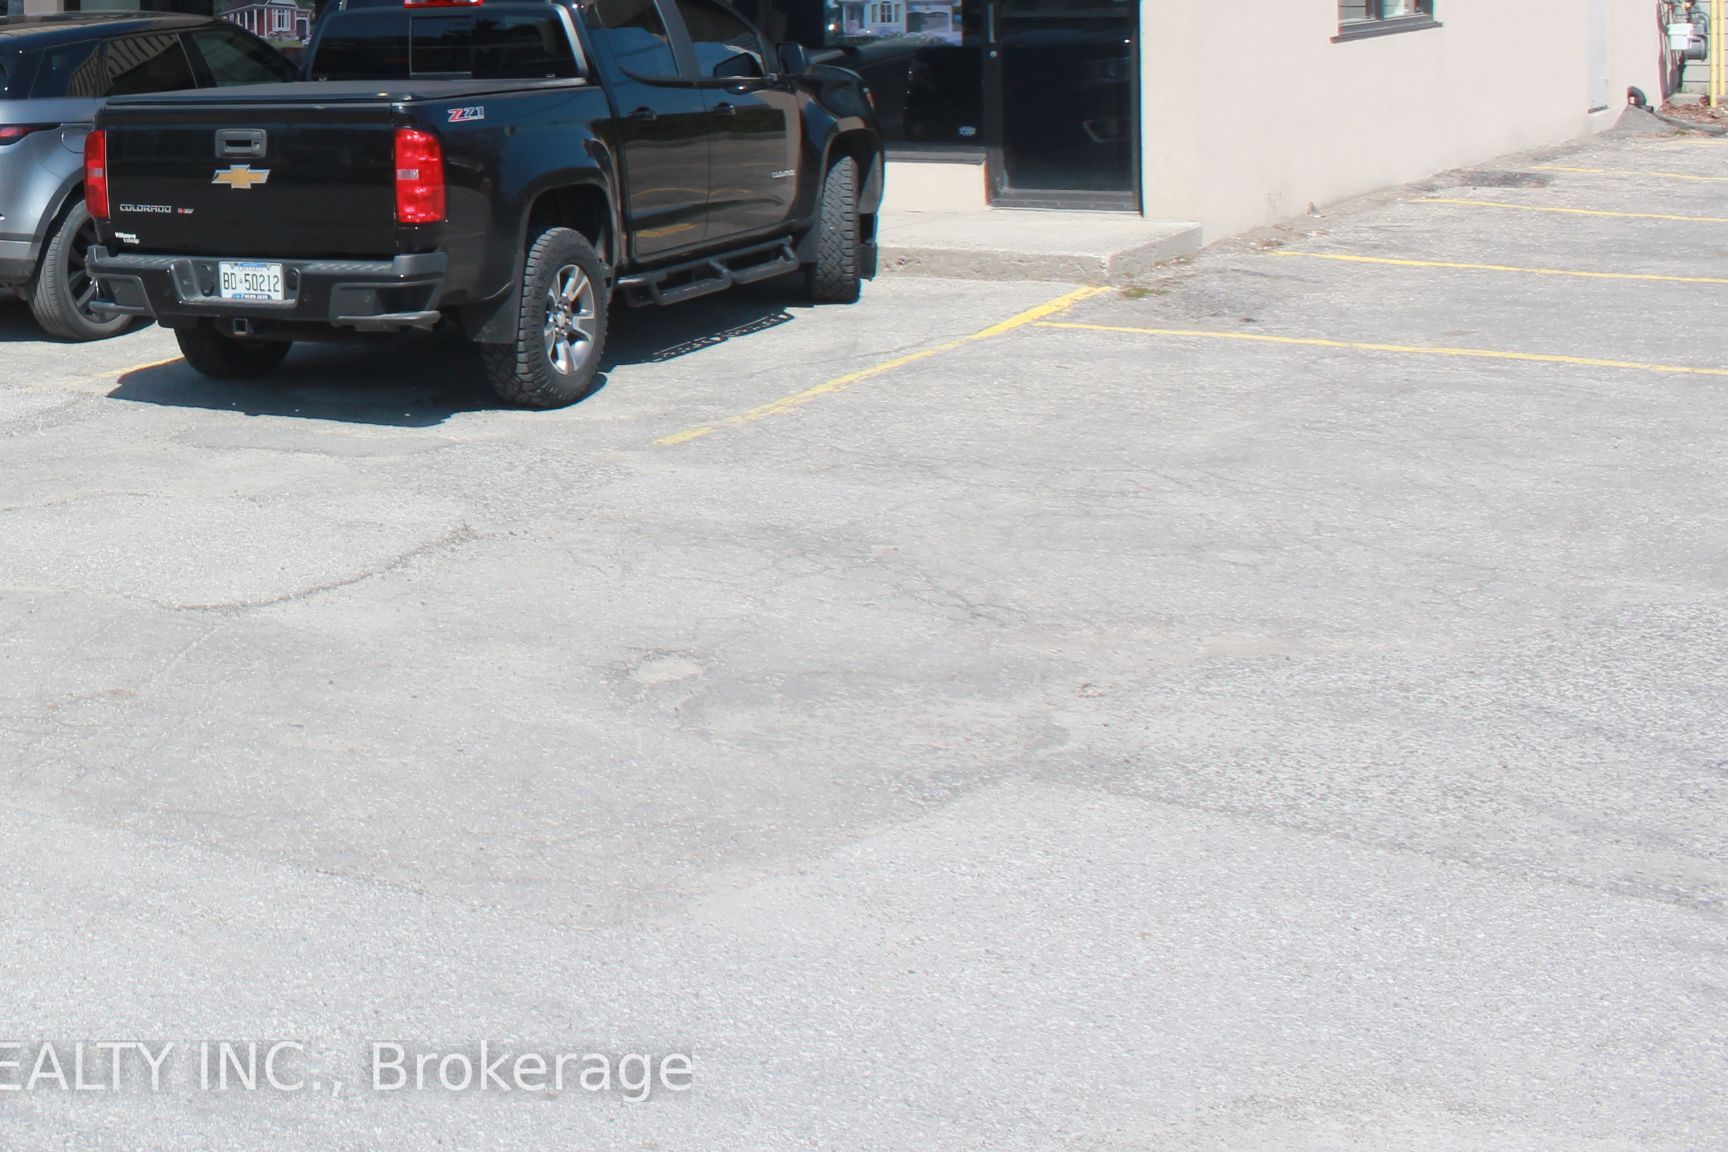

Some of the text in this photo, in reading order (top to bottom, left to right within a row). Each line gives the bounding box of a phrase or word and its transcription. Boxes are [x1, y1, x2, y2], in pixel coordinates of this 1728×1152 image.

[447, 105, 485, 123] Z71
[119, 203, 172, 214] COLORADO
[222, 272, 281, 292] BD 50212
